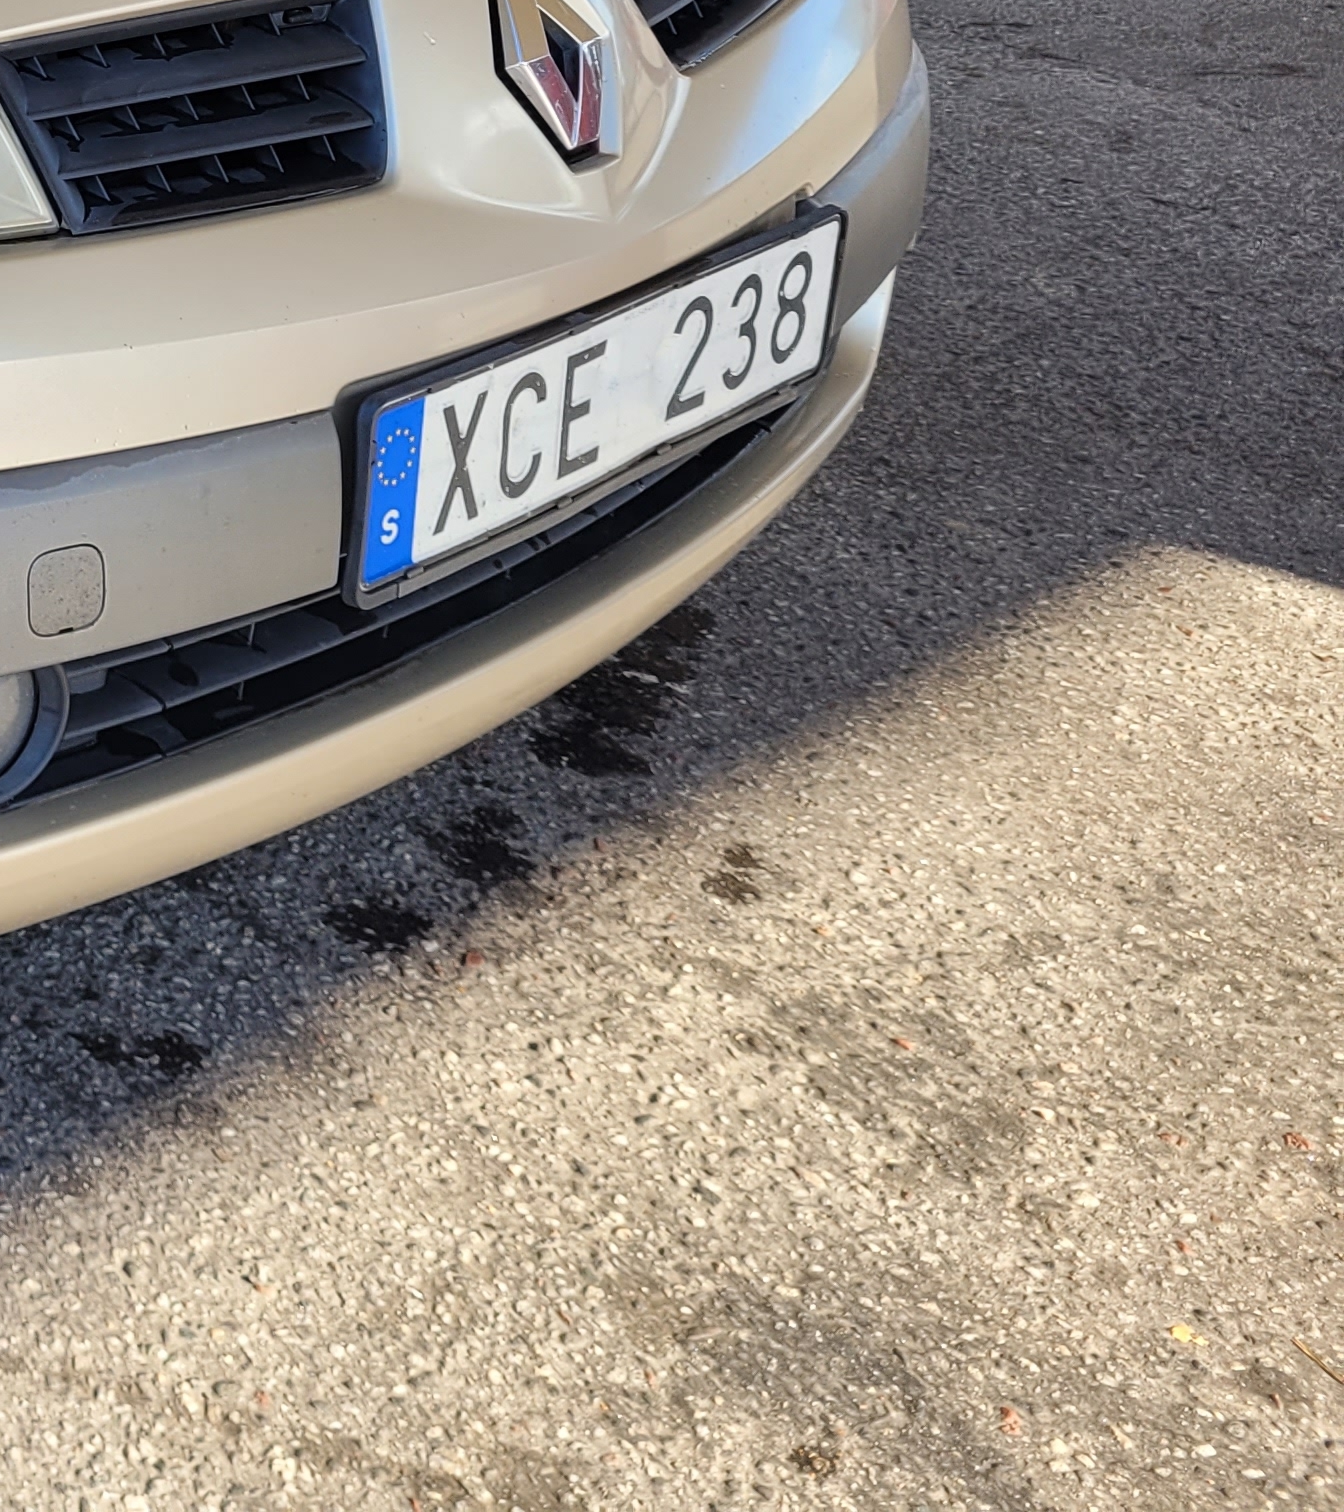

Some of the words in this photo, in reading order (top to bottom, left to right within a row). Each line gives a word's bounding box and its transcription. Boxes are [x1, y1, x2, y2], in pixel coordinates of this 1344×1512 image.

[431, 339, 608, 537] XCE
[665, 250, 813, 422] 238
[379, 508, 402, 546] S
